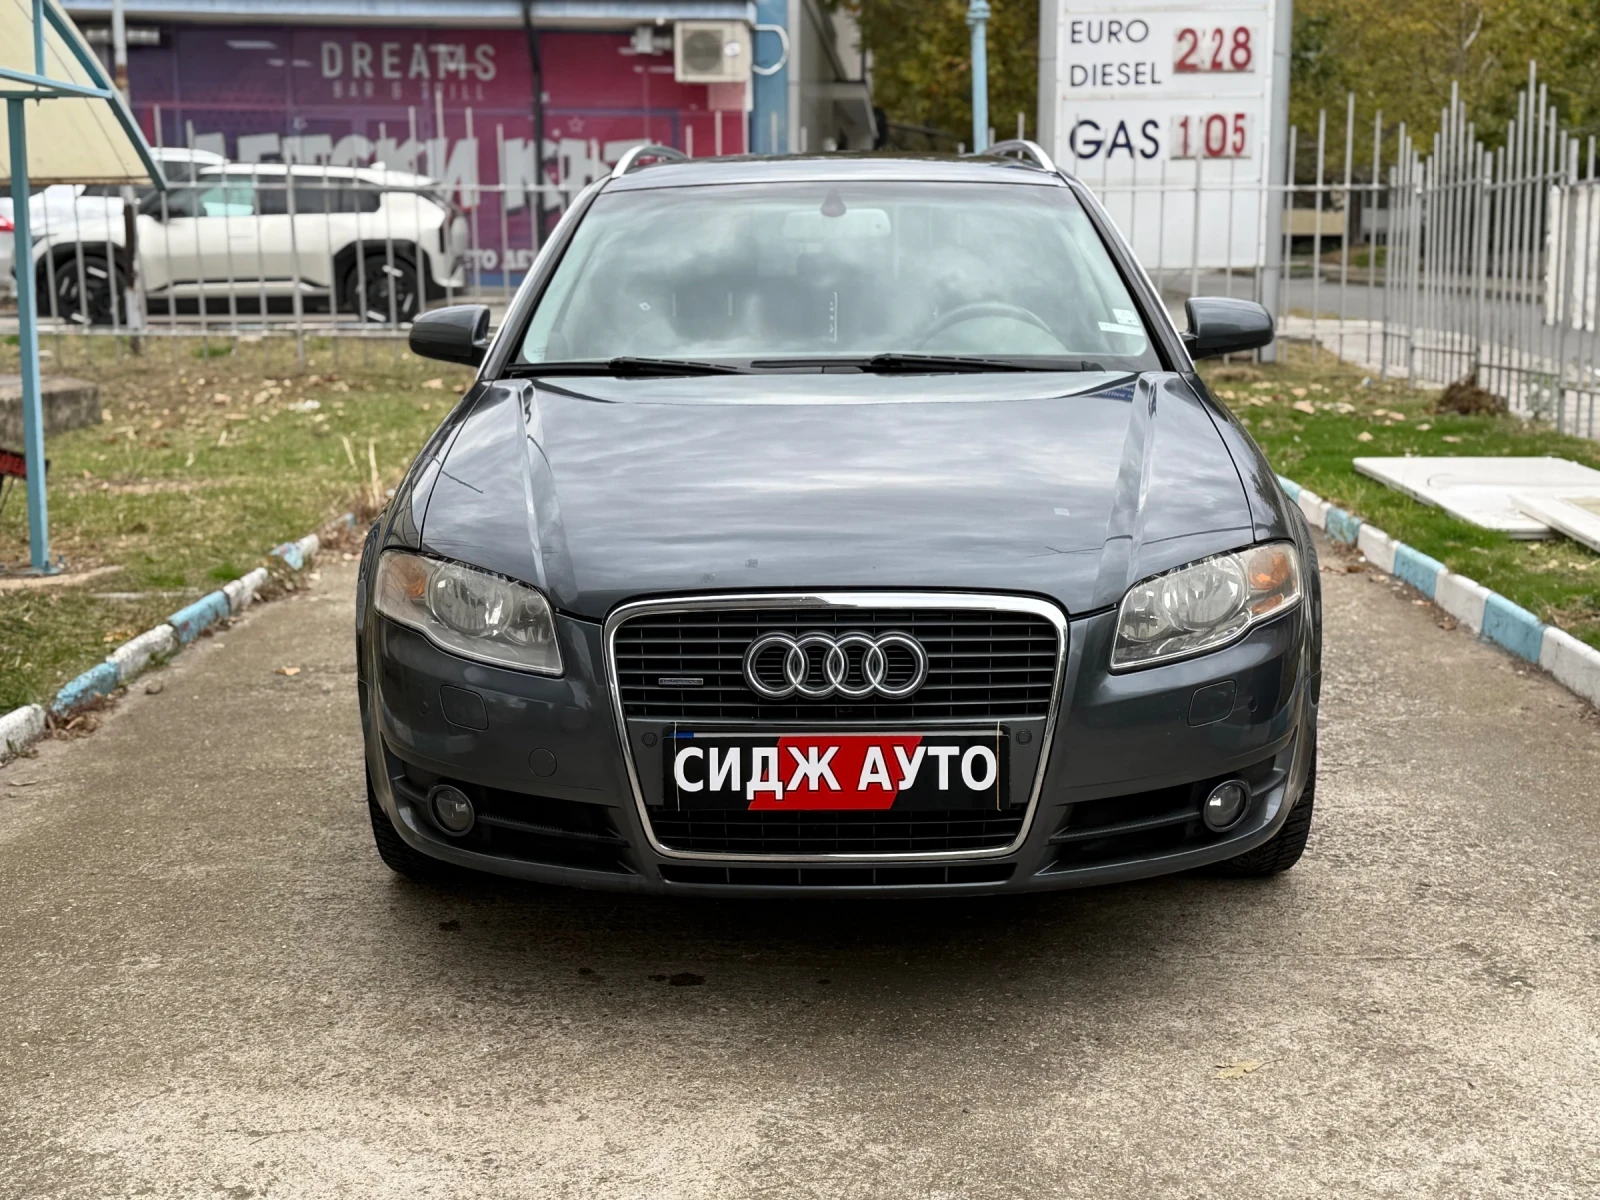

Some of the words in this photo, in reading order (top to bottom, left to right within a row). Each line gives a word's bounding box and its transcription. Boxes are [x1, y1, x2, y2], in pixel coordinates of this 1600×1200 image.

[1071, 19, 1149, 44] EURO
[321, 41, 497, 81] DREAMS
[1070, 62, 1162, 87] DIESEL
[1069, 119, 1160, 159] GAS
[674, 746, 842, 800] СИДЖ
[857, 745, 997, 791] АУТО
